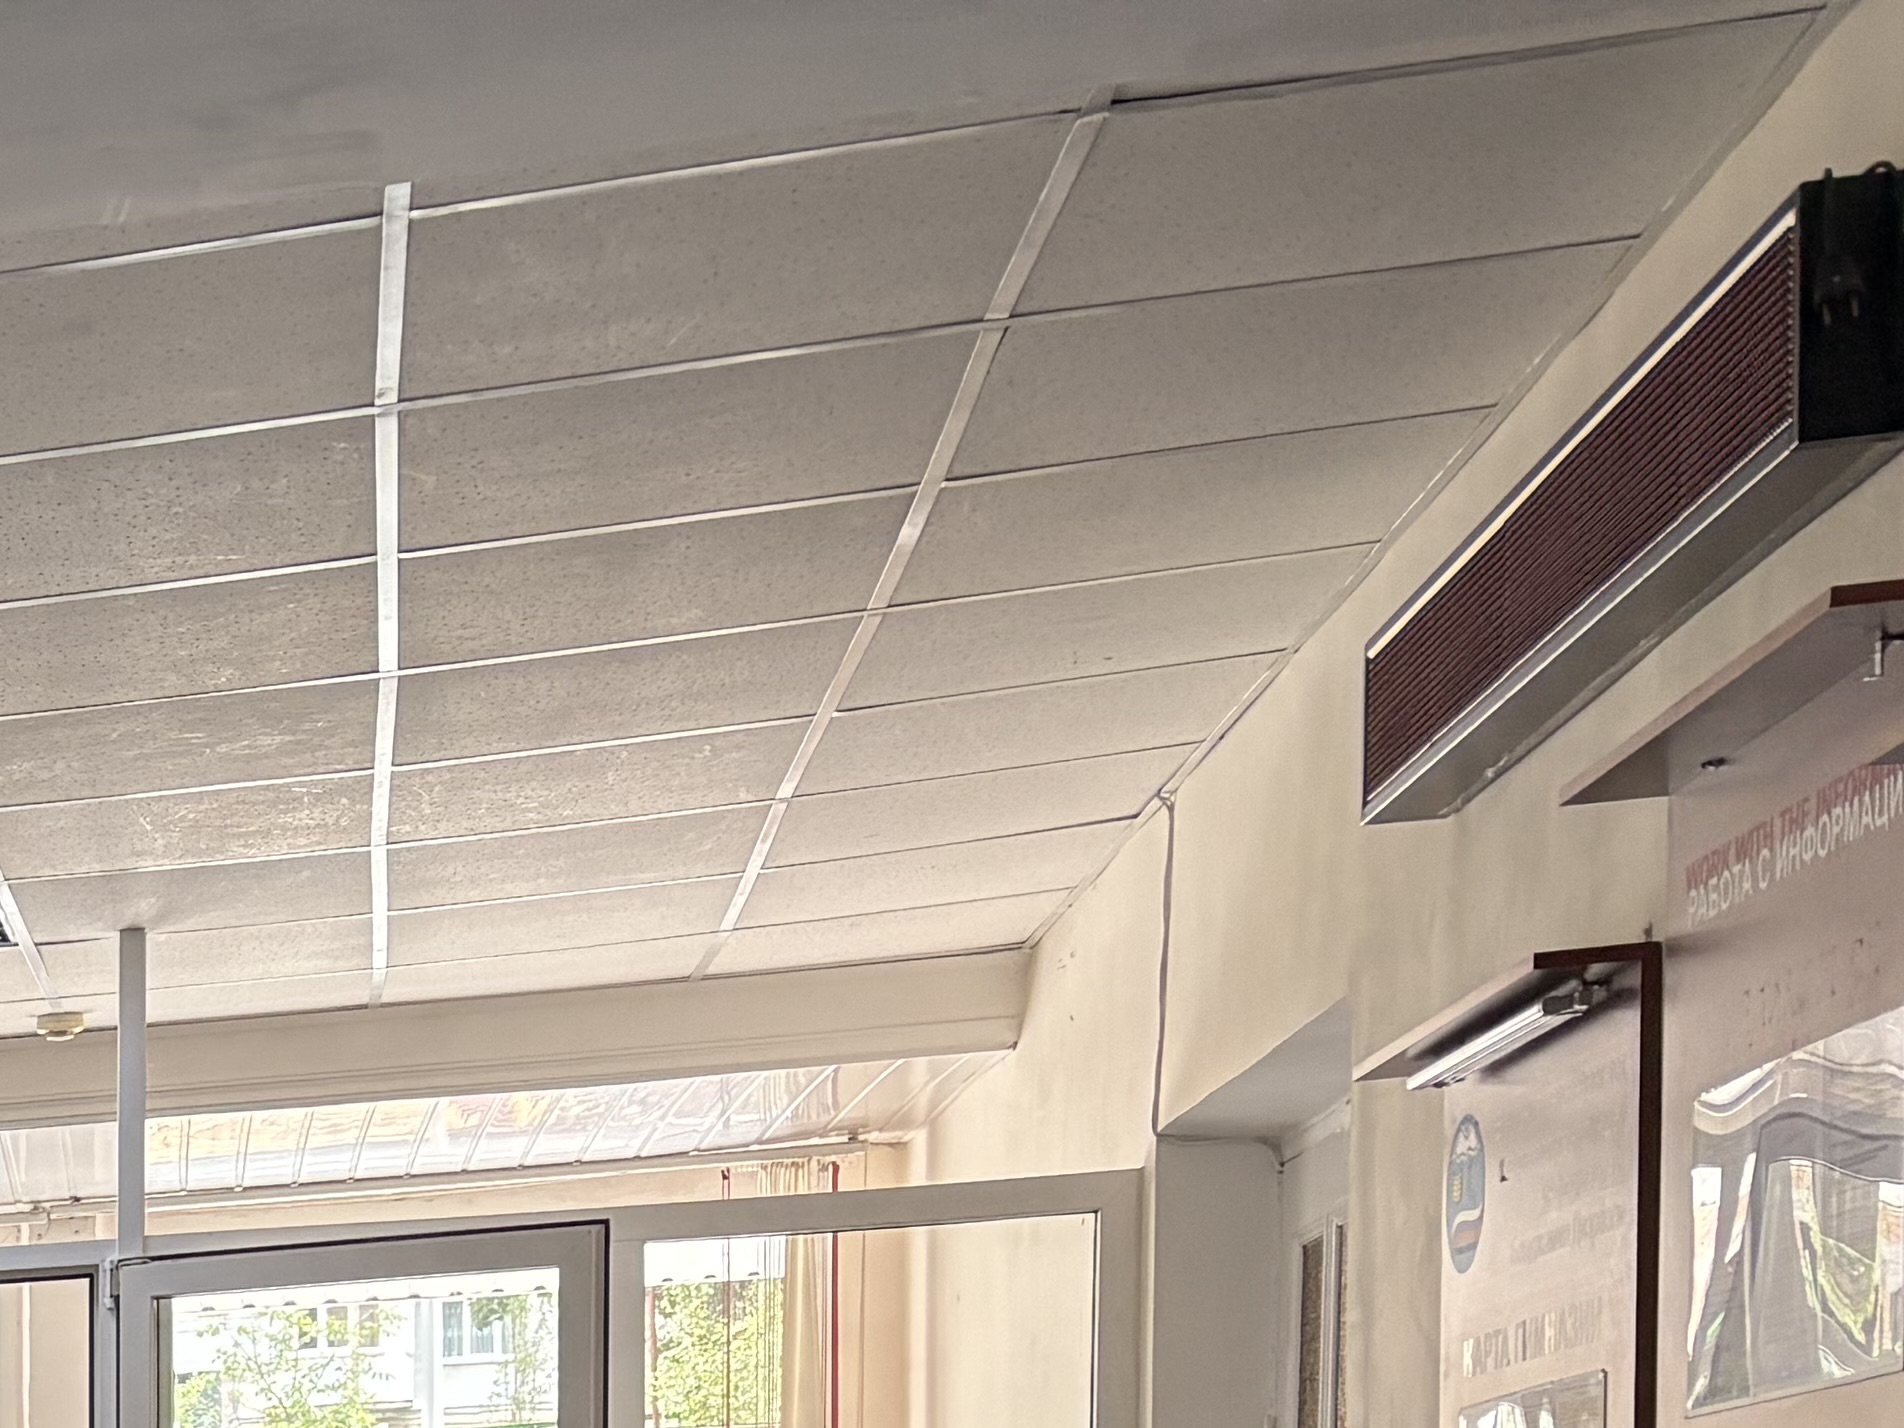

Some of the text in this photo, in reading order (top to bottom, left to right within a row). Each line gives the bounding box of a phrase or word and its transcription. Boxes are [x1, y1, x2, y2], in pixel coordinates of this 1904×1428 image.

[1688, 857, 1754, 929] РАБОТА
[1758, 848, 1772, 892] С
[1463, 1327, 1511, 1379] КАРТА
